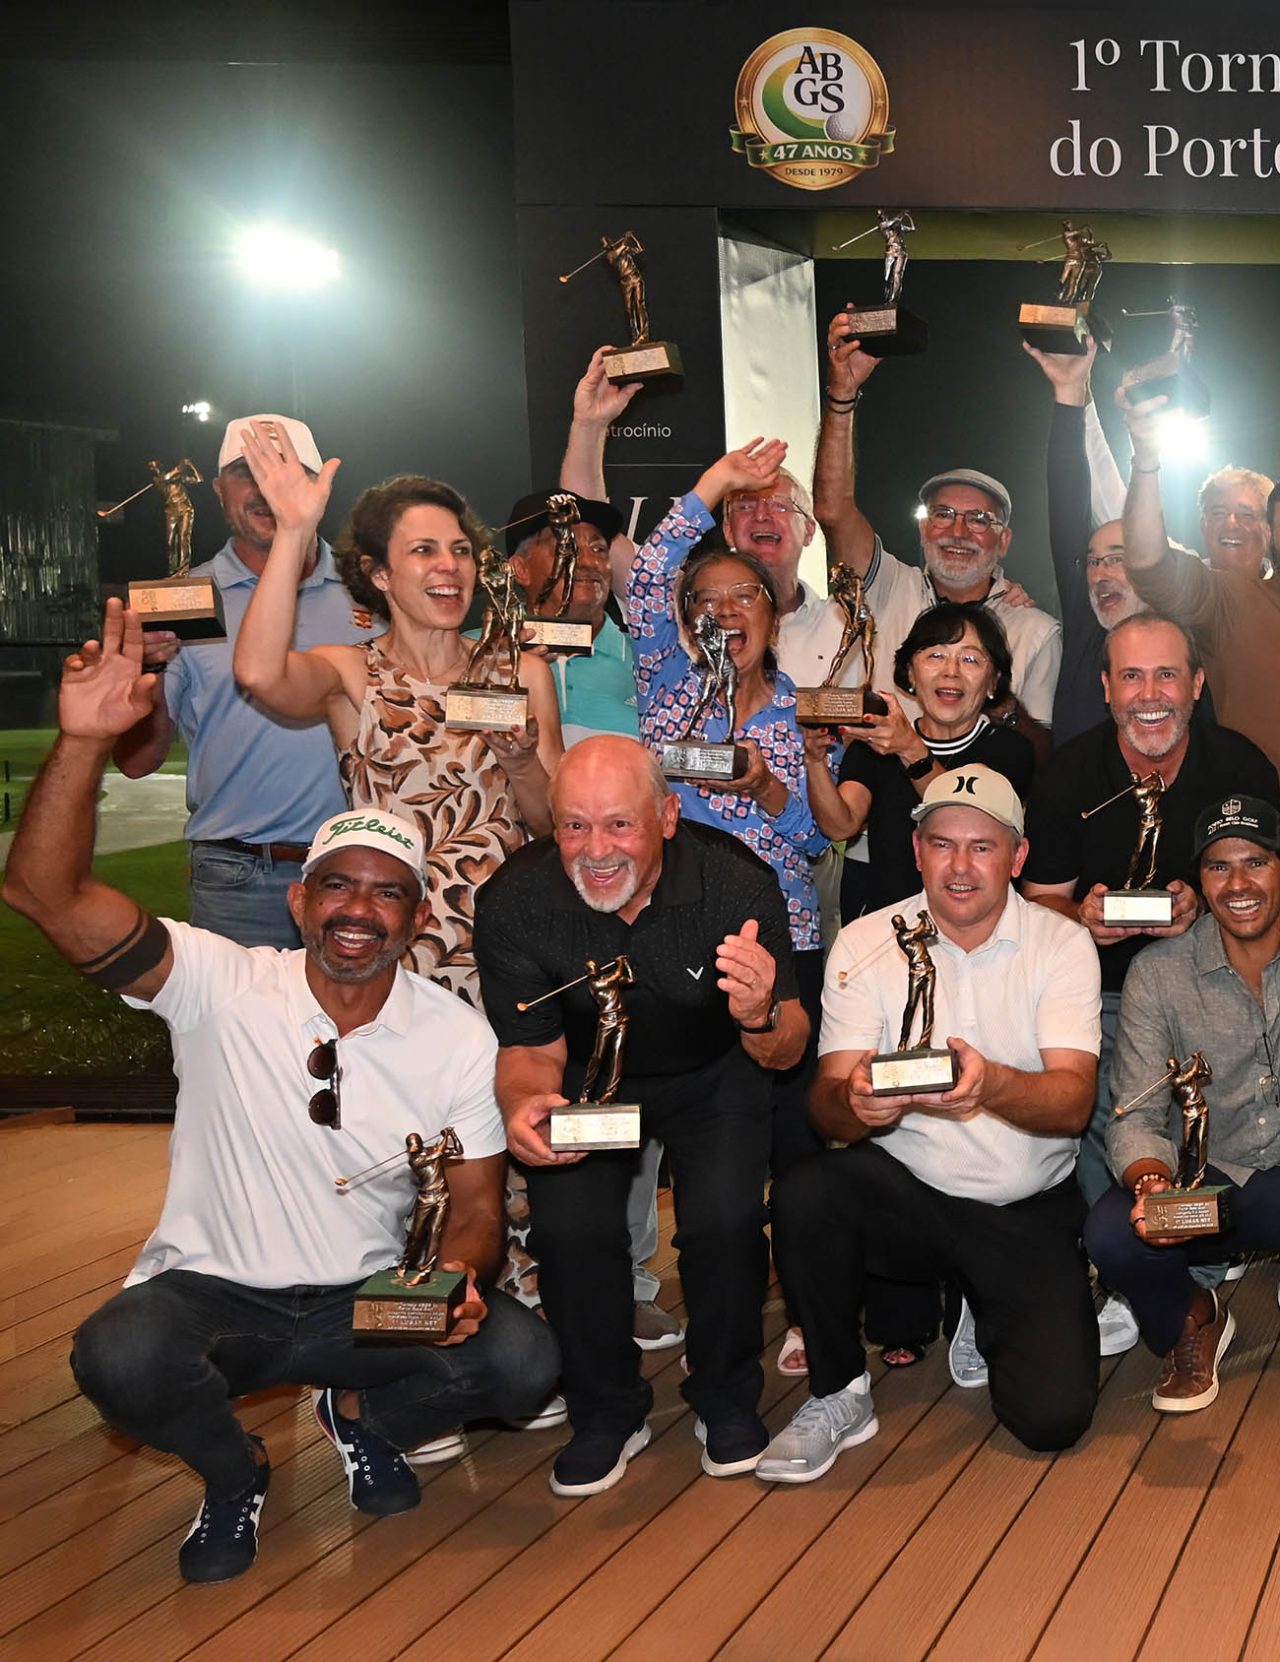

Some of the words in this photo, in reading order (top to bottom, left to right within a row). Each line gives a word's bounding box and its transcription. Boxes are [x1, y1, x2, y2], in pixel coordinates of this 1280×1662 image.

[1069, 37, 1121, 93] 1º
[773, 145, 798, 159] 47
[801, 145, 853, 161] ANOS
[1049, 119, 1122, 179] do
[785, 167, 816, 177] DESDE
[819, 167, 844, 177] 1979
[322, 816, 414, 850] Titleist
